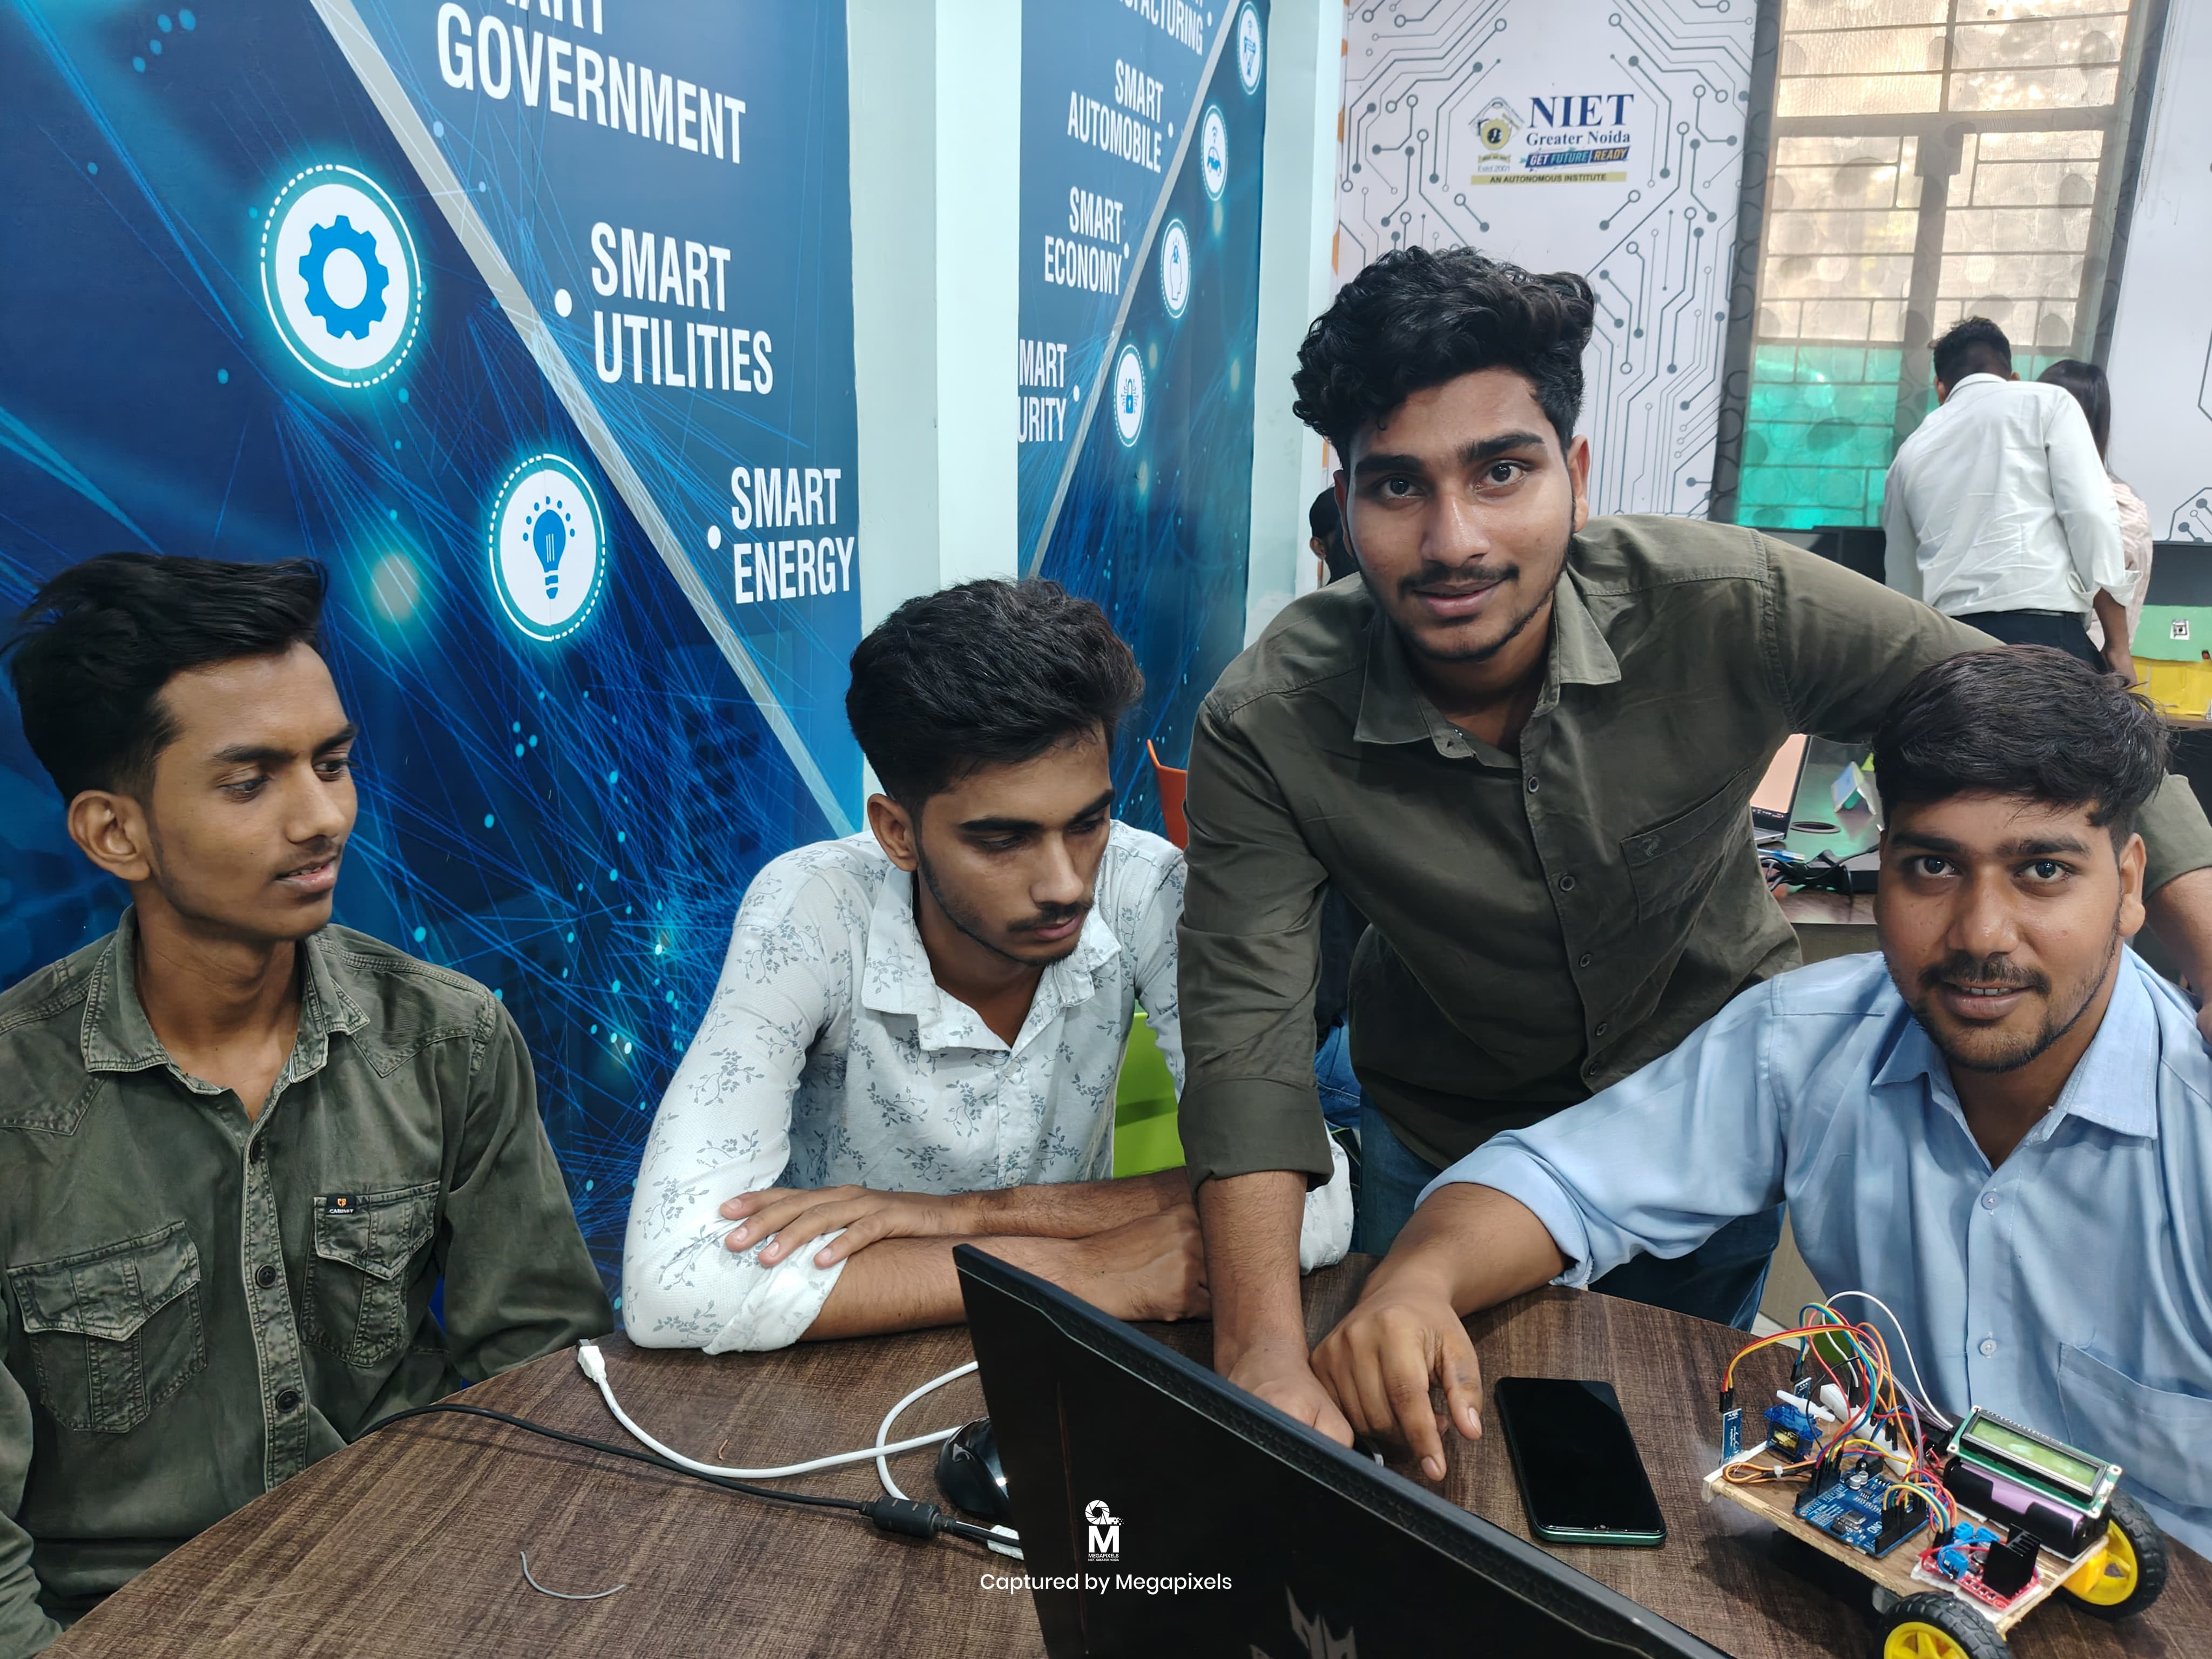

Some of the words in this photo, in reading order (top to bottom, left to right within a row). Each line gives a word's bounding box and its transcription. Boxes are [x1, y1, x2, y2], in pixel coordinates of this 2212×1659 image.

[1119, 0, 1203, 56] CTURING
[437, 2, 746, 164] GOVERNMENT
[1115, 58, 1164, 123] SMART
[1528, 94, 1634, 129] NIET
[1067, 91, 1162, 173] AUTOMOBILE
[1526, 132, 1583, 146] Greater
[1587, 130, 1630, 144] Noida
[1530, 154, 1550, 166] GET
[1550, 151, 1589, 164] FUTURE
[1594, 149, 1628, 161] READY
[1503, 174, 1562, 183] AUTONOMOUS
[1564, 173, 1607, 181] INSTITUTE
[1069, 186, 1123, 245] SMART
[591, 222, 731, 312] SMART
[1044, 235, 1122, 295] ECONOMY
[594, 310, 773, 395] UTILITIES
[1019, 339, 1068, 388] MART
[1017, 396, 1067, 443] URITY
[731, 466, 841, 530] SMART
[733, 536, 854, 604] ENERGY
